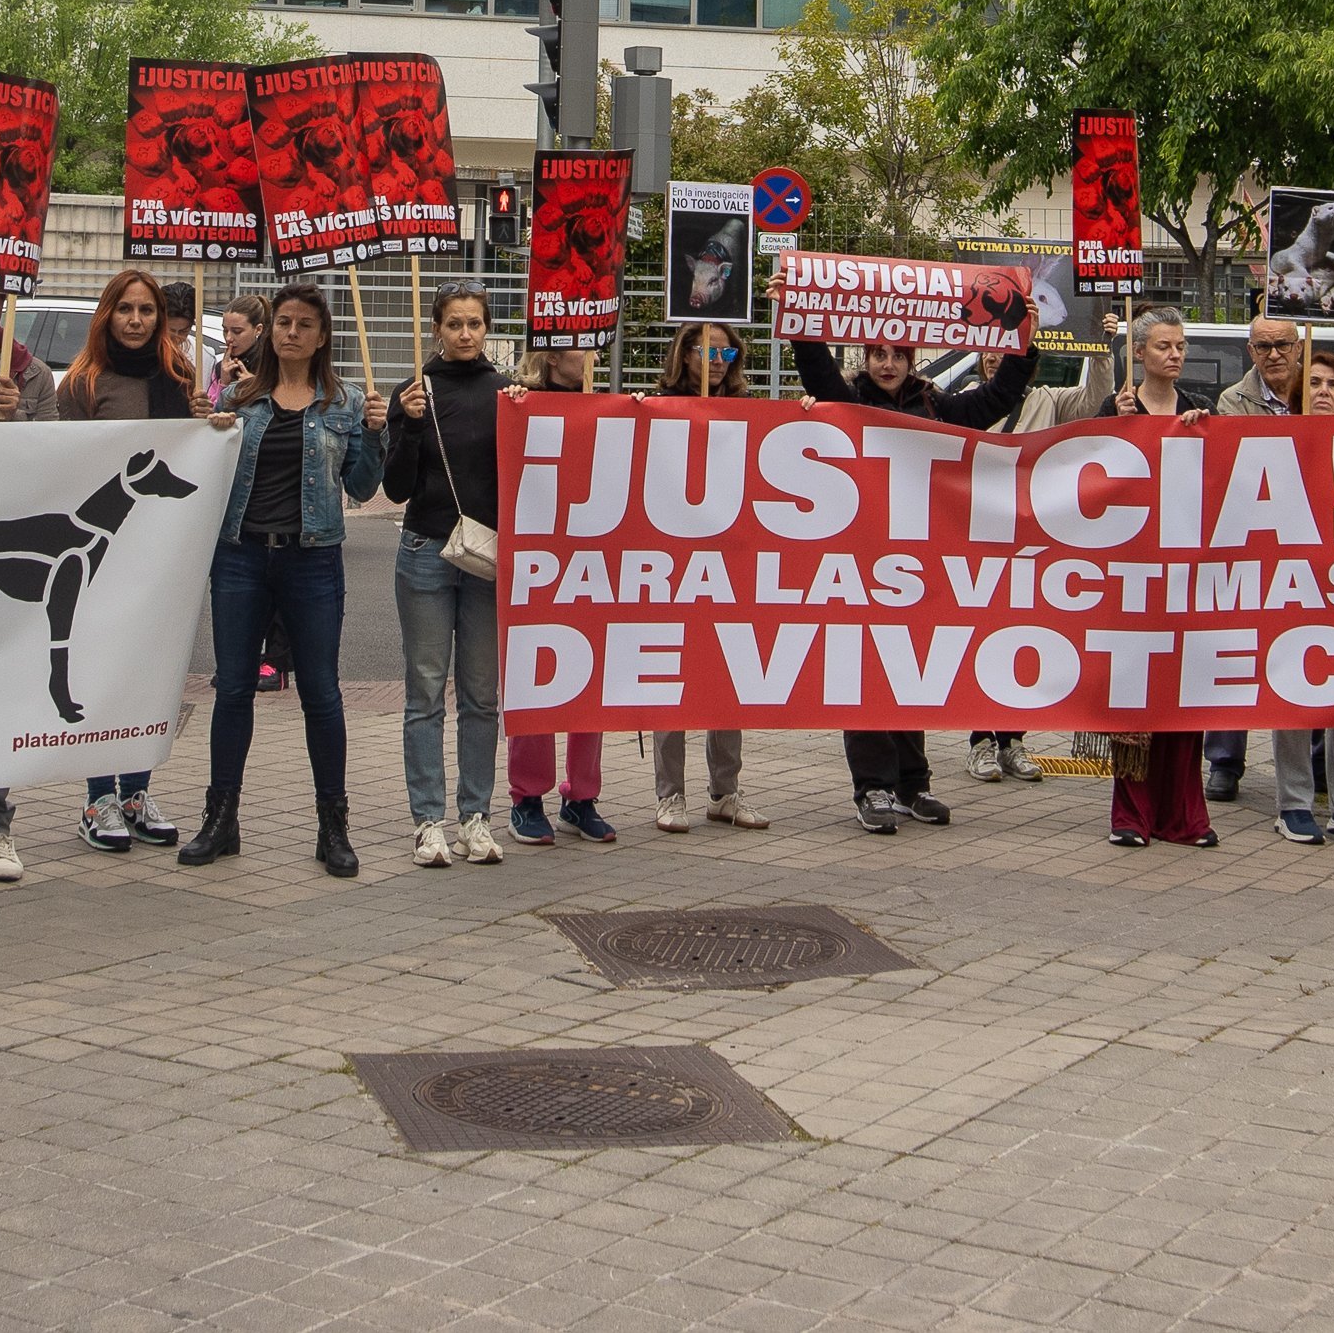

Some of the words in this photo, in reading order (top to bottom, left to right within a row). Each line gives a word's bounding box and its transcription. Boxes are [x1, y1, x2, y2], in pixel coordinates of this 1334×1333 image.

[139, 67, 246, 91] ¡JUSTICIA
[672, 187, 683, 197] En
[685, 188, 693, 197] la
[694, 188, 749, 200] investigación
[133, 199, 164, 209] PARA
[394, 202, 455, 220] VÍCTIMAS
[672, 198, 688, 208] NO
[692, 199, 720, 210] TODO
[723, 200, 749, 212] VALE
[132, 210, 167, 225] LAS
[171, 207, 257, 228] VÍCTIMAS
[274, 210, 307, 224] PARA
[275, 219, 312, 240] LAS
[314, 208, 376, 236] VÍCTIMAS
[132, 225, 153, 238] DE
[157, 226, 256, 241] VIVOTECNIA
[382, 221, 457, 234] VIVOTECNIA
[279, 239, 302, 254] DE
[765, 236, 781, 244] ZONA
[957, 239, 1012, 254] VÍCTIMA
[1013, 245, 1030, 254] DE
[1079, 240, 1102, 250] PARA
[1079, 250, 1106, 263] LAS
[786, 257, 963, 298] ¡JUSTICIA!
[1079, 265, 1096, 276] DE
[977, 273, 1000, 292] 32
[534, 292, 562, 301] PARA
[534, 301, 565, 316] LAS
[785, 291, 833, 312] PARA
[836, 294, 875, 315] LAS
[875, 294, 963, 320] VÍCTIMAS
[533, 316, 553, 330] DE
[781, 312, 824, 337] DE
[829, 314, 1021, 350] VIVOTECNIA
[1044, 331, 1059, 340] DE
[1060, 332, 1074, 340] LA
[1066, 342, 1110, 352] ANIMAL
[510, 550, 737, 606] PARA
[755, 551, 925, 608] LAS
[503, 621, 685, 711] DE
[12, 721, 168, 752] plataformanac.org
